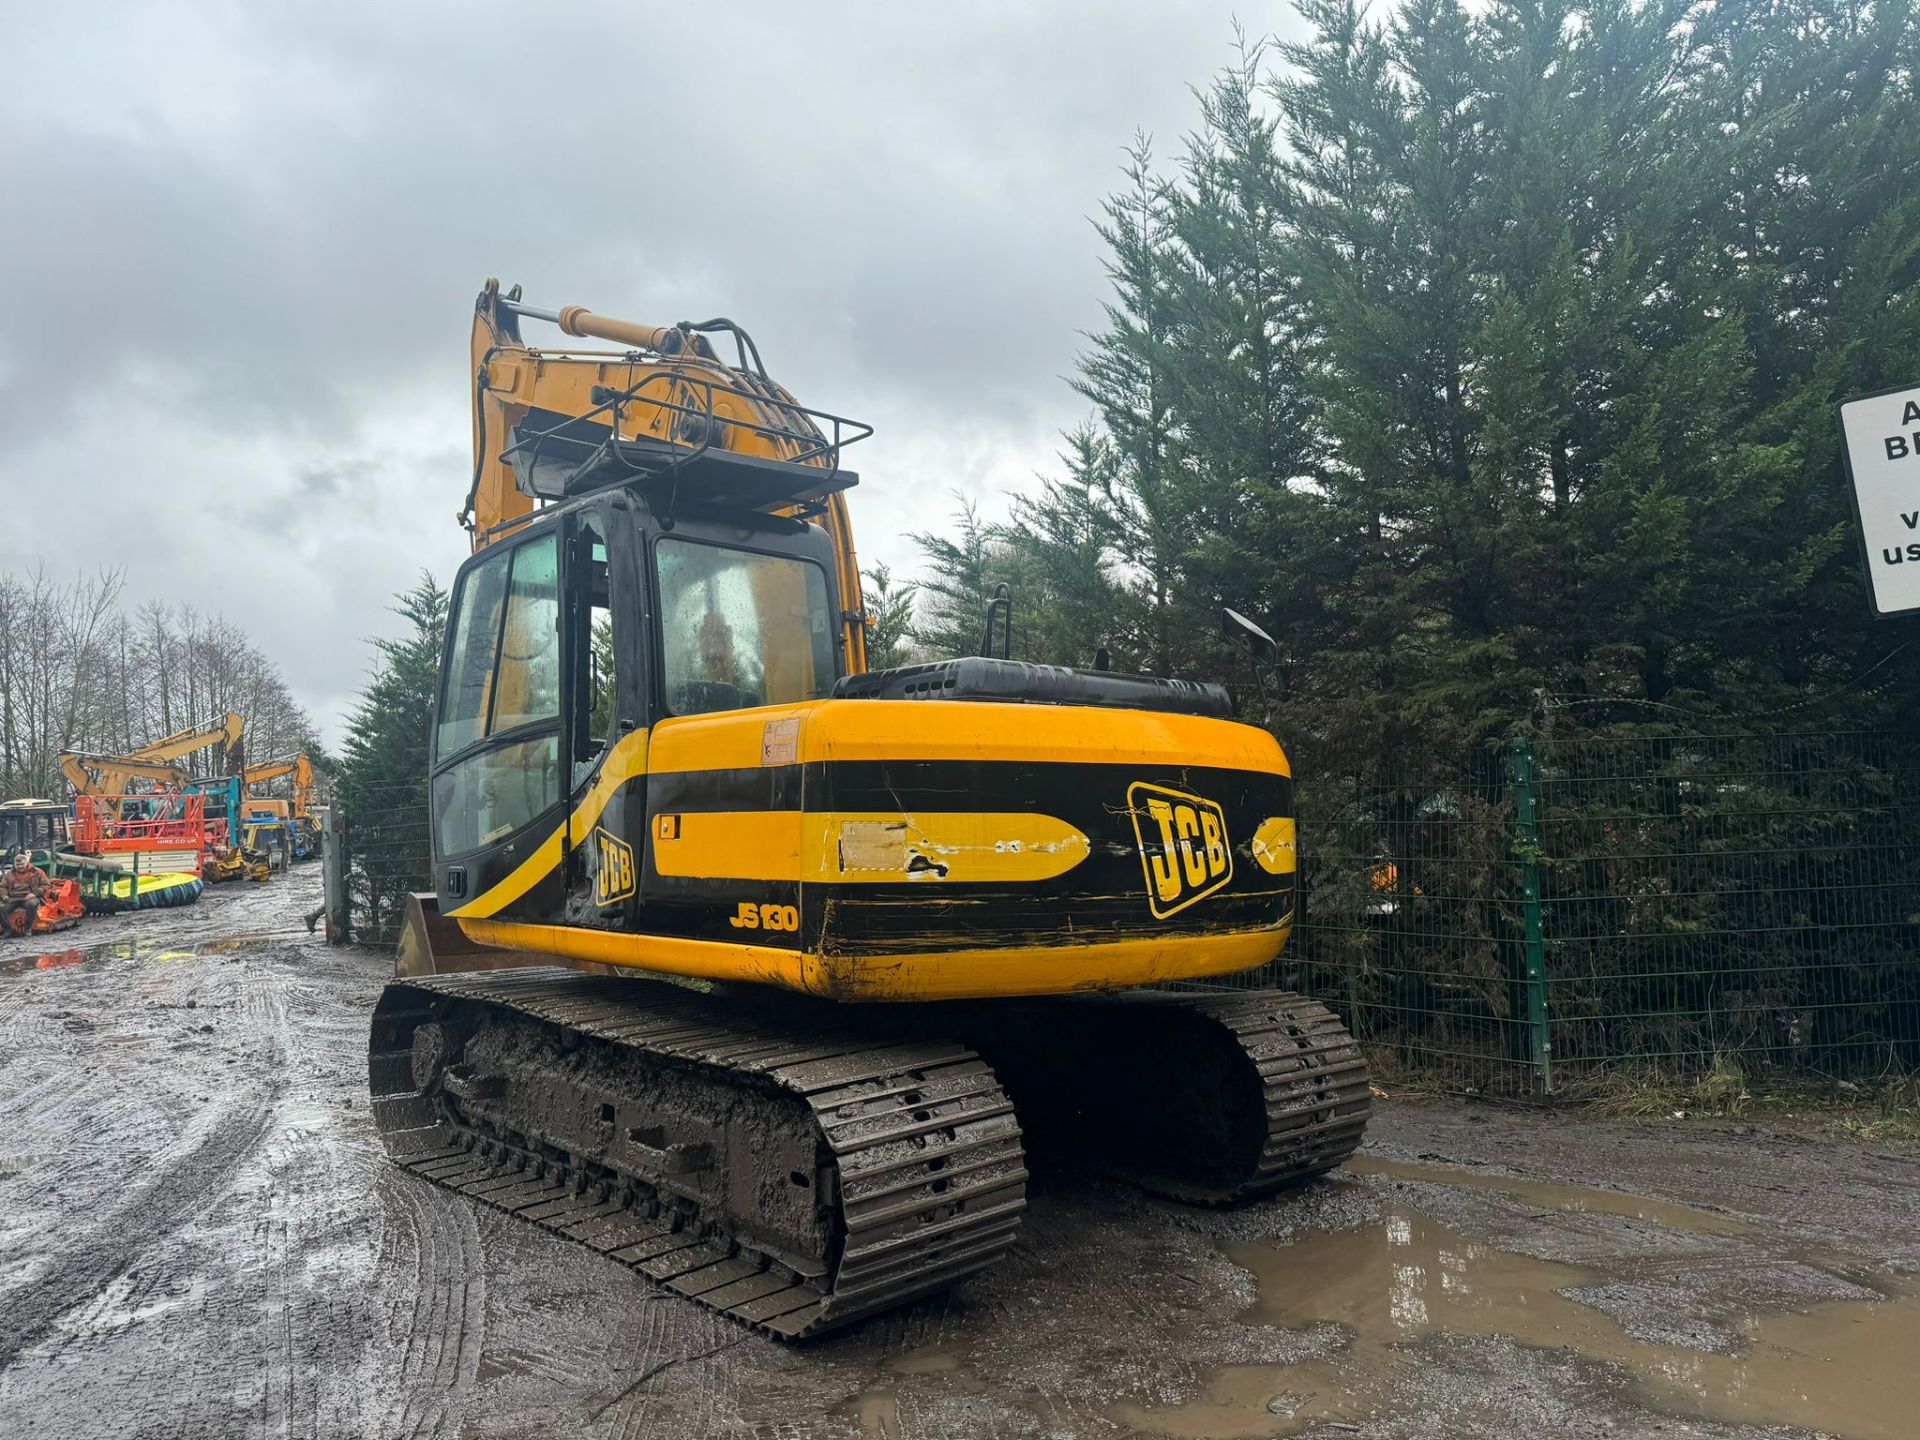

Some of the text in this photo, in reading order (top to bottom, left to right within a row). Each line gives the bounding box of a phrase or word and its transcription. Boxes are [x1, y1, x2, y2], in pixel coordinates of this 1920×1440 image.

[600, 835, 632, 897] JCB
[1147, 798, 1226, 902] JCB
[729, 902, 799, 932] JS130
